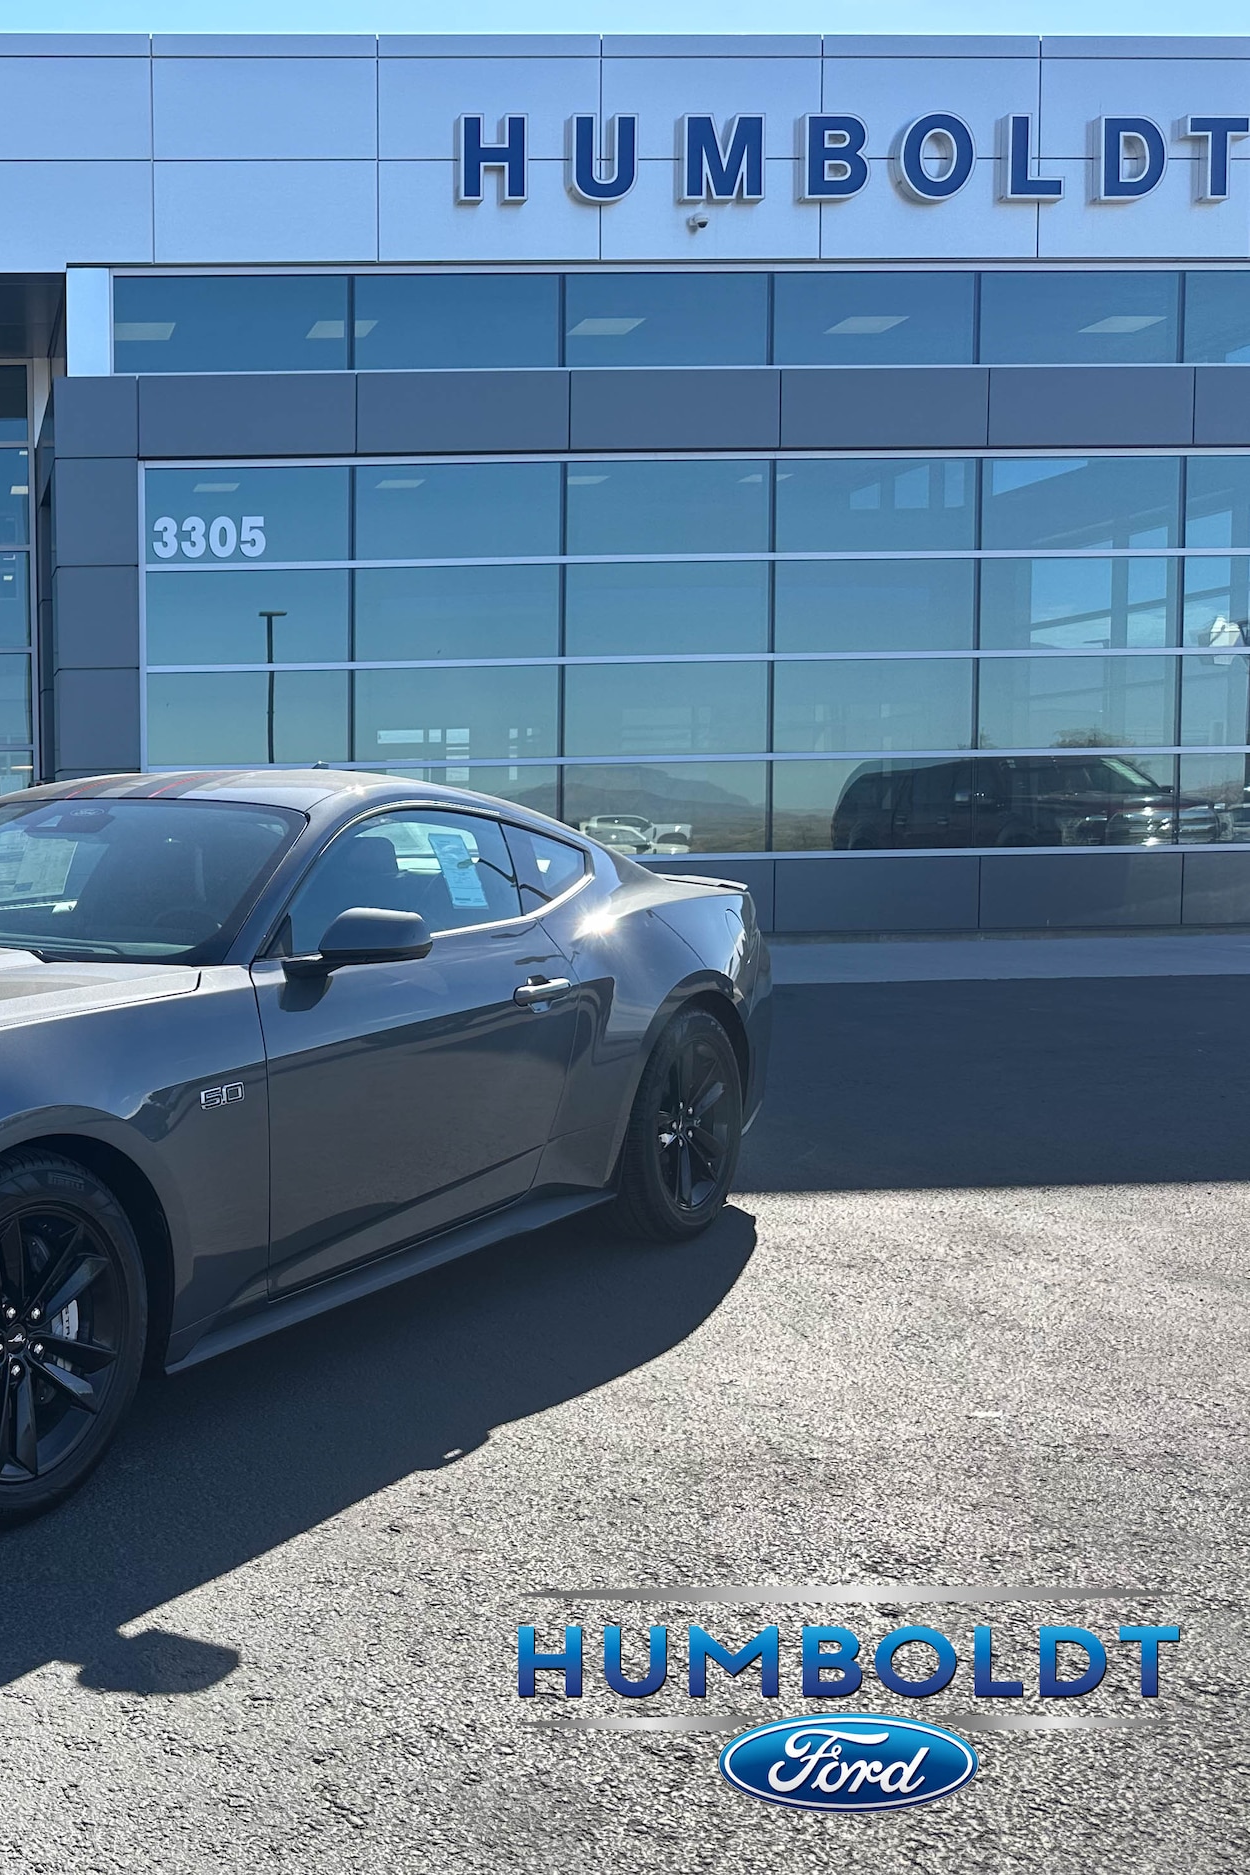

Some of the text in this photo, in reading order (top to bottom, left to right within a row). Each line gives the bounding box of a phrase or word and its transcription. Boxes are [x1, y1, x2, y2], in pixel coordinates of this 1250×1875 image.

[456, 110, 1250, 205] HUMBOLDT
[152, 515, 267, 559] 3305
[200, 1081, 245, 1110] 5.0
